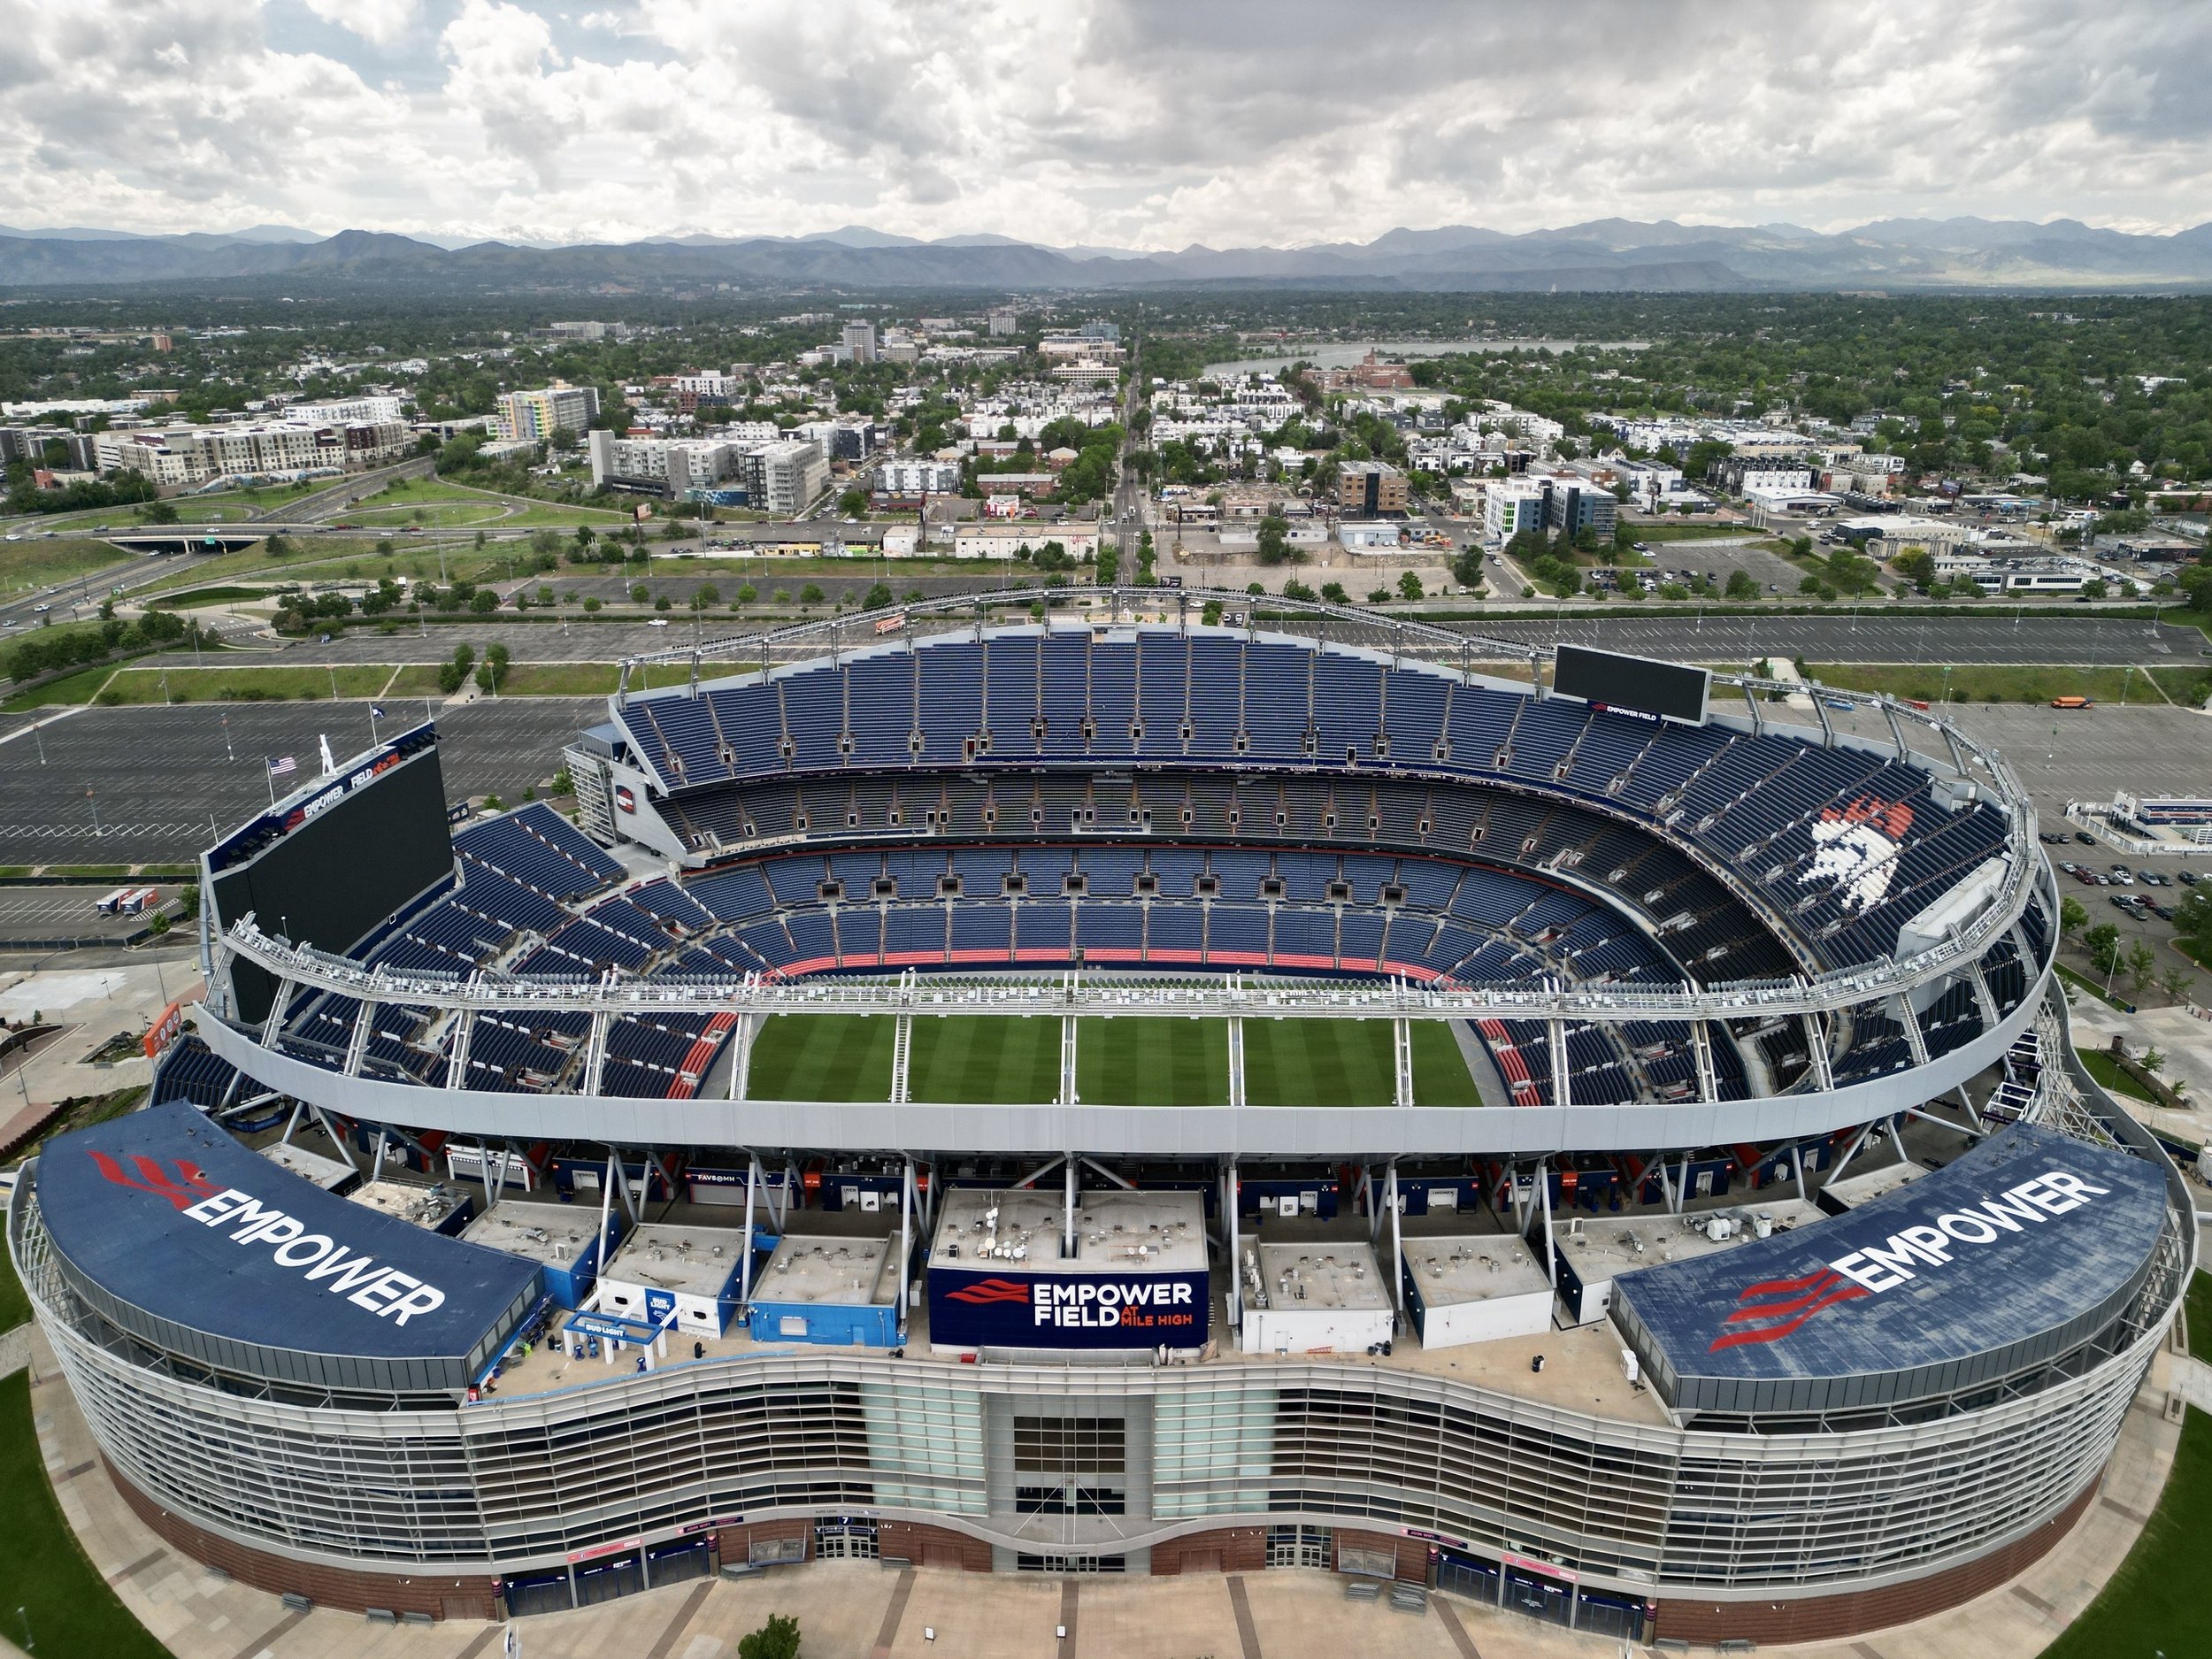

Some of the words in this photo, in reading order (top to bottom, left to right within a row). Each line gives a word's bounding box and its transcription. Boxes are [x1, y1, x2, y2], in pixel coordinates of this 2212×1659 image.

[1607, 706, 1638, 718] EMPOWER
[1639, 712, 1656, 721] FIELD
[303, 785, 344, 818] EMPOWER
[350, 768, 373, 788] FIELD
[1828, 1171, 2110, 1294] EMPOWER
[181, 1188, 445, 1327] EMPOWER
[652, 1296, 667, 1305] BUD
[1033, 1283, 1192, 1305] EMPOWER
[649, 1302, 670, 1310] LIGHT
[1034, 1306, 1120, 1327] FIELD
[1121, 1306, 1138, 1316] AT
[1121, 1316, 1153, 1326] MILE
[1157, 1314, 1192, 1325] HIGH
[585, 1324, 602, 1333] BUD
[602, 1326, 625, 1337] LIGHT
